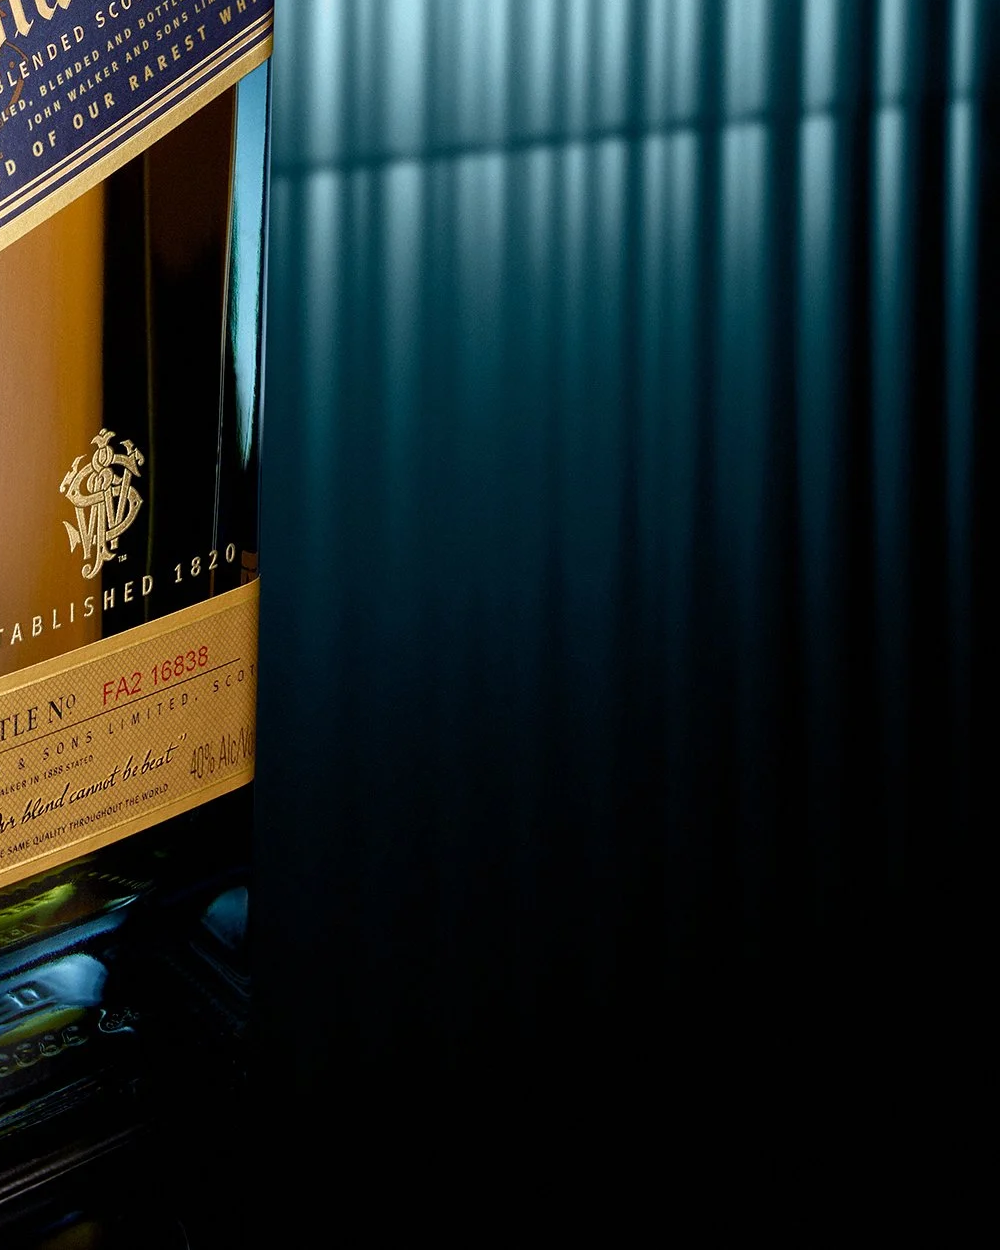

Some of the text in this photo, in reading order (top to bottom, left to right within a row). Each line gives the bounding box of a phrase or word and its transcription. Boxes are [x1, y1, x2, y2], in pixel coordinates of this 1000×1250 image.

[27, 100, 62, 131] JOHN
[67, 61, 119, 102] WALKER
[125, 39, 150, 64] AND
[155, 11, 189, 42] SONS
[32, 131, 57, 158] OF
[72, 92, 116, 130] OUR
[128, 25, 206, 91] RAREST
[38, 49, 100, 97] BLENDED
[106, 27, 132, 52] AND
[173, 543, 236, 583] 1820
[102, 671, 143, 706] FA2
[151, 645, 209, 686] 16838
[18, 758, 26, 770] &
[43, 730, 93, 761] SONS
[30, 775, 40, 786] IN
[44, 765, 63, 781] 1888
[65, 754, 94, 772] STATED
[189, 743, 216, 781] 40%
[7, 838, 31, 855] SAME
[32, 824, 67, 848] QUALITY
[69, 802, 123, 831] THROUGHOUT
[125, 795, 140, 808] THE
[141, 783, 169, 801] WORLD
[20, 782, 71, 825] blend
[68, 765, 121, 804] cannot
[122, 755, 140, 782] be
